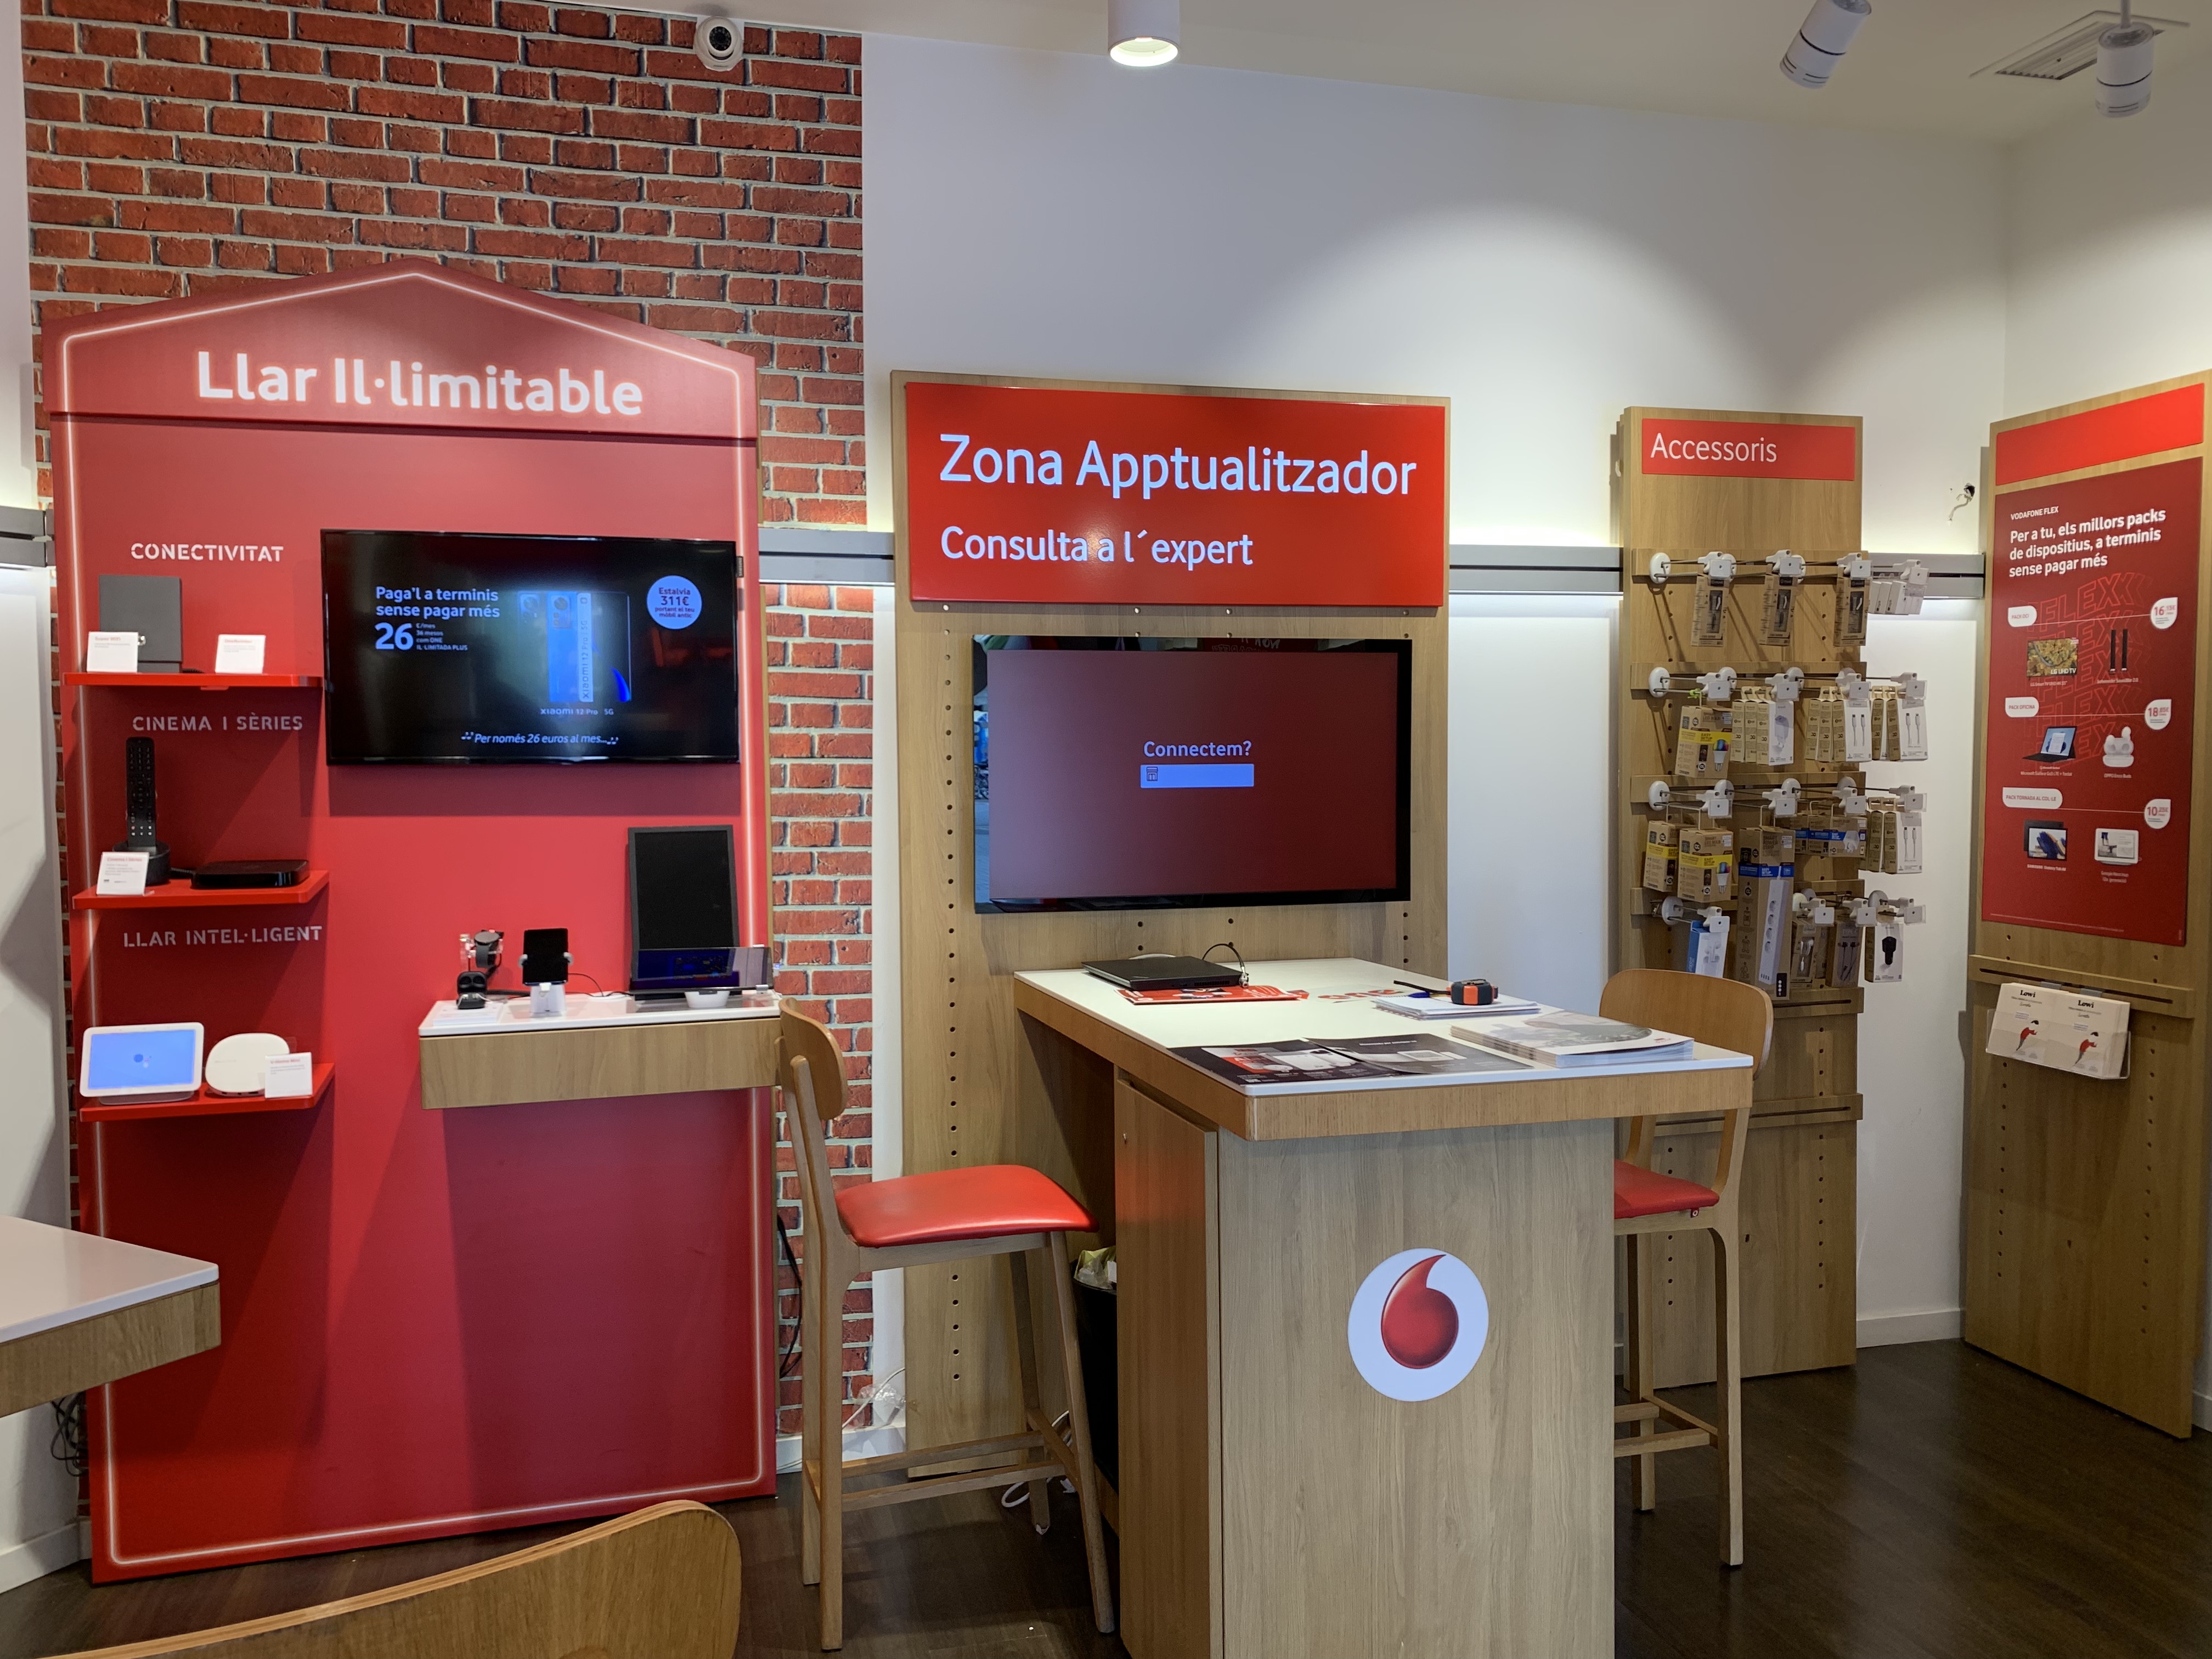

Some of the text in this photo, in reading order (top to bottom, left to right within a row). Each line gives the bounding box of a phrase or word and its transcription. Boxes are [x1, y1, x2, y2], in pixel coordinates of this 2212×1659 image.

[198, 351, 644, 415] Llar Il·limitable
[1650, 432, 1777, 463] Accessoris
[940, 433, 1416, 499] Zona Apptualitzador
[2011, 506, 2058, 520] VODAFONE FLEX
[2010, 509, 2166, 543] Per a tu, els millors packs
[131, 542, 284, 562] CONECTIVITAT
[940, 526, 1088, 561] Consulta
[1097, 535, 1114, 562] a
[2010, 527, 2162, 560] de dispositius, a terminis
[2009, 552, 2108, 577] sense pagar més
[376, 586, 498, 602] Paga'l a terminis
[659, 587, 691, 595] Estalvia
[661, 596, 689, 606] 311€
[376, 605, 500, 619] sense pagar més
[2154, 606, 2164, 616] 16
[375, 622, 414, 650] 26
[2148, 707, 2158, 716] 18
[132, 712, 303, 731] CINEMA I SÈRIES
[475, 734, 491, 743] Per
[493, 733, 525, 743] només
[527, 733, 540, 743] 26
[541, 735, 568, 743] euros
[570, 734, 579, 743] al
[1144, 740, 1252, 758] Connectem?
[2147, 806, 2158, 816] 10
[123, 926, 323, 947] LLAR INTEL·LIGENT
[2020, 990, 2036, 998] Lowi
[2078, 1000, 2094, 1008] Lowi
